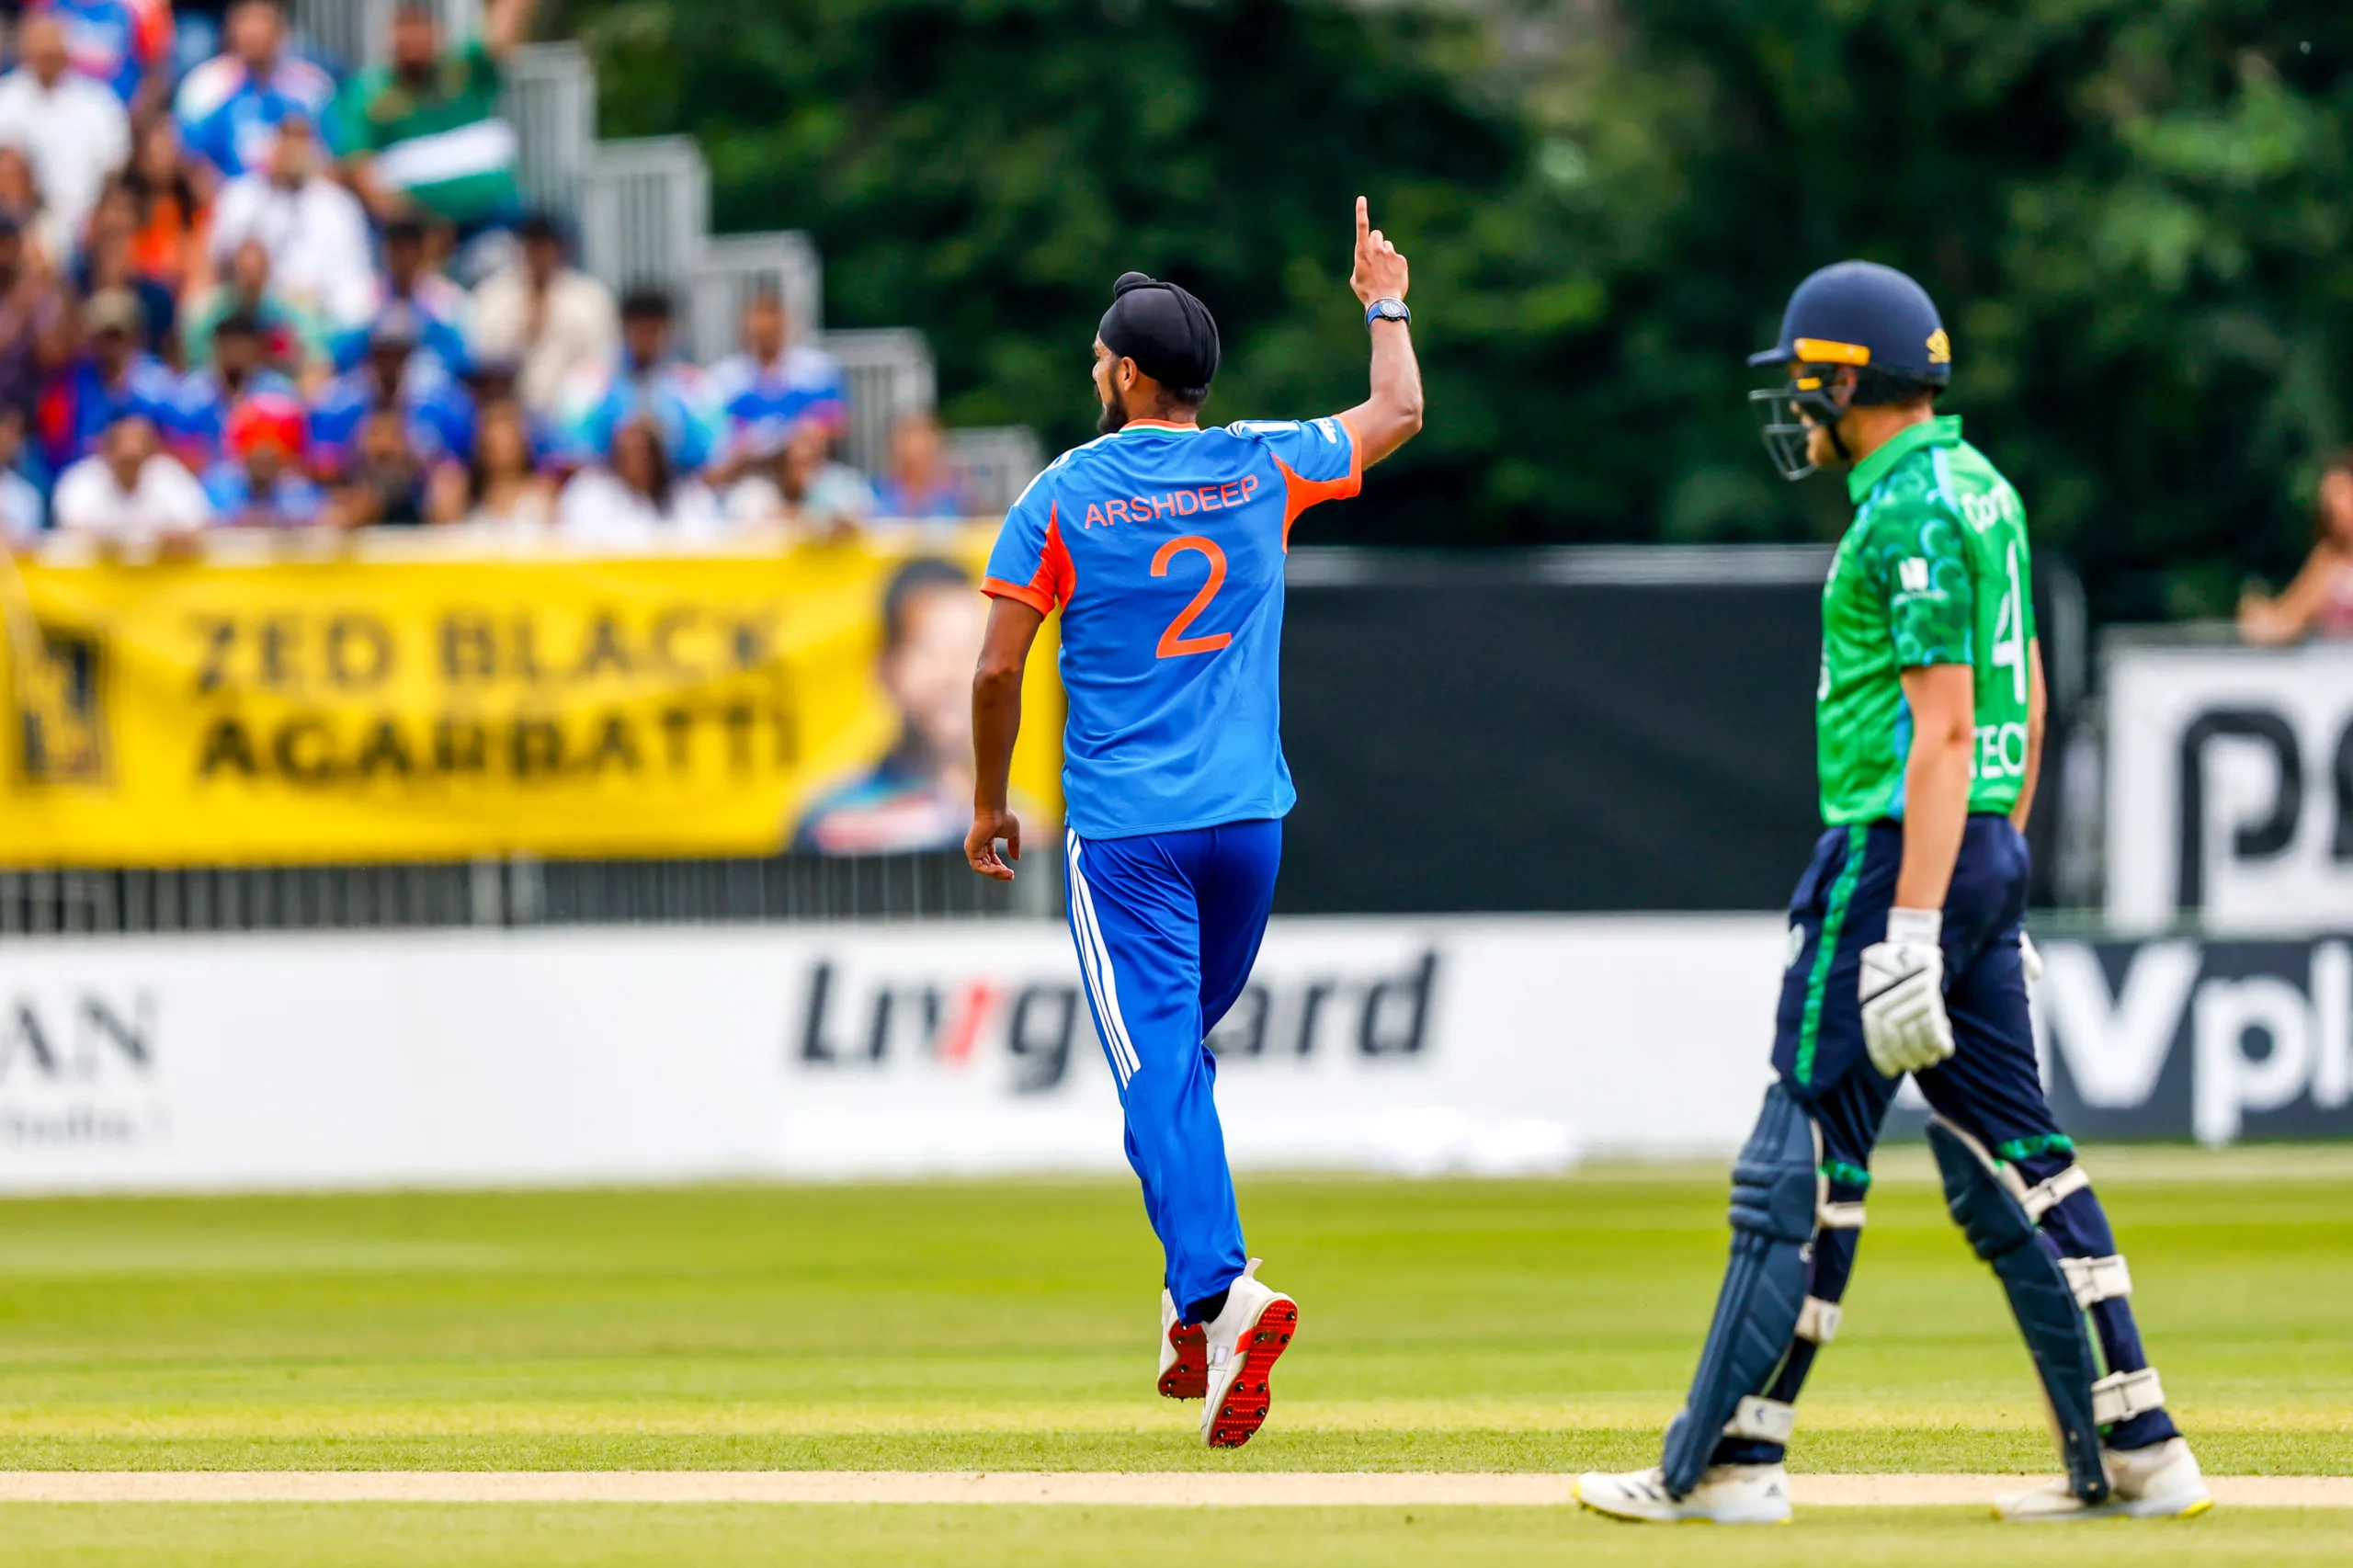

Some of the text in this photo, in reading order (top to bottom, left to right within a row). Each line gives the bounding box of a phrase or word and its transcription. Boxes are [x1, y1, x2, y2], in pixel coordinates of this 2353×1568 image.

[1085, 474, 1259, 529] ARSHDEEP
[197, 608, 779, 691] ZED BLACK
[1150, 535, 1233, 659] 2
[1992, 540, 2027, 705] 4
[798, 952, 1439, 1094] Livgard
[2029, 941, 2353, 1145] Vpl
